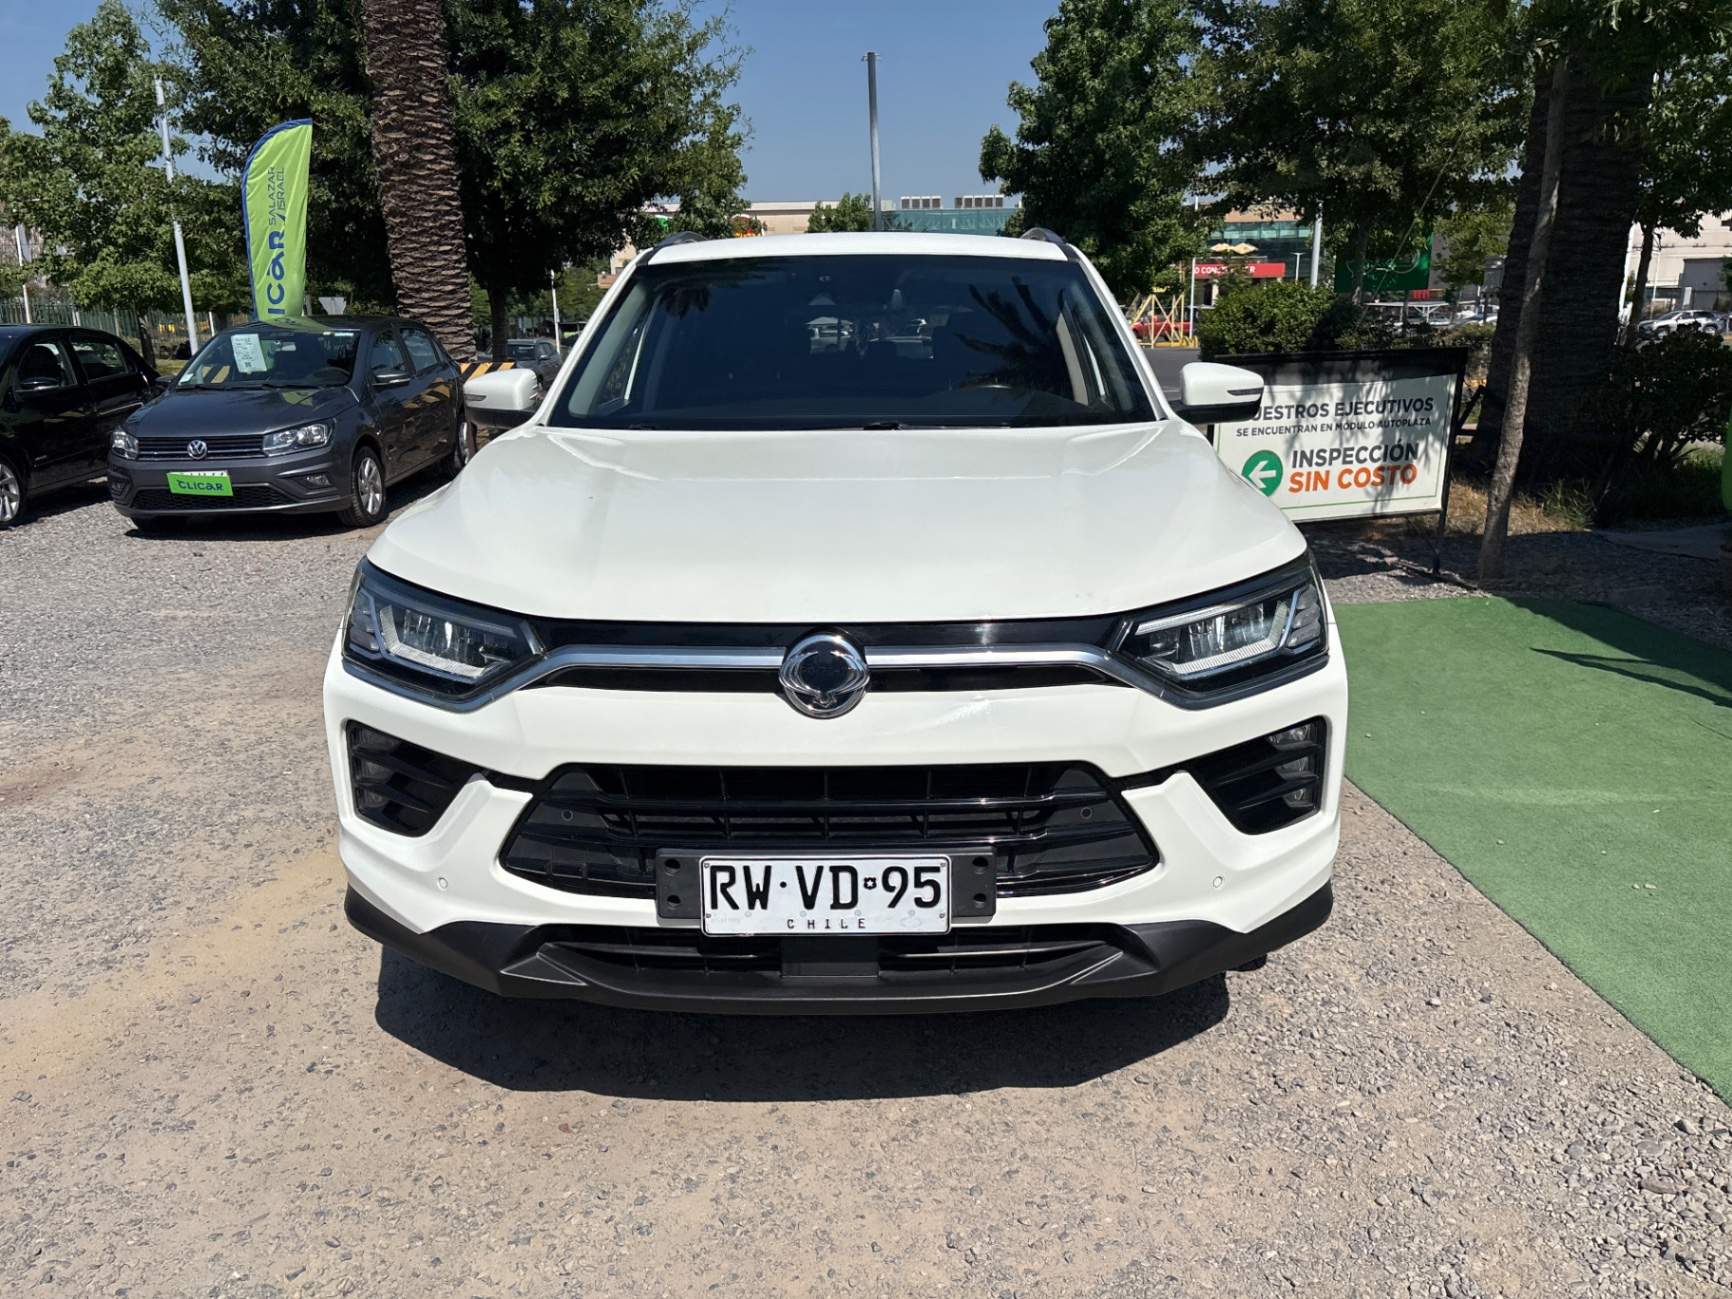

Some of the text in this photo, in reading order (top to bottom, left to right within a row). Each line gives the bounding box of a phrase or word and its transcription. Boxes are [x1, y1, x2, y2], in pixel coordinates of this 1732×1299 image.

[267, 166, 277, 226] SALAZAR
[276, 167, 286, 210] ISRAEL
[1251, 397, 1434, 421] UESTROS EJECUTIVOS
[1236, 427, 1249, 437] SE
[1251, 424, 1318, 436] ENCUENTRAN
[1320, 423, 1333, 432] EN
[1377, 417, 1432, 429] AUTOPLAZA
[1291, 439, 1420, 469] INSPECCIÓN
[1288, 463, 1418, 494] SIN COSTO
[786, 918, 866, 929] CHILE
